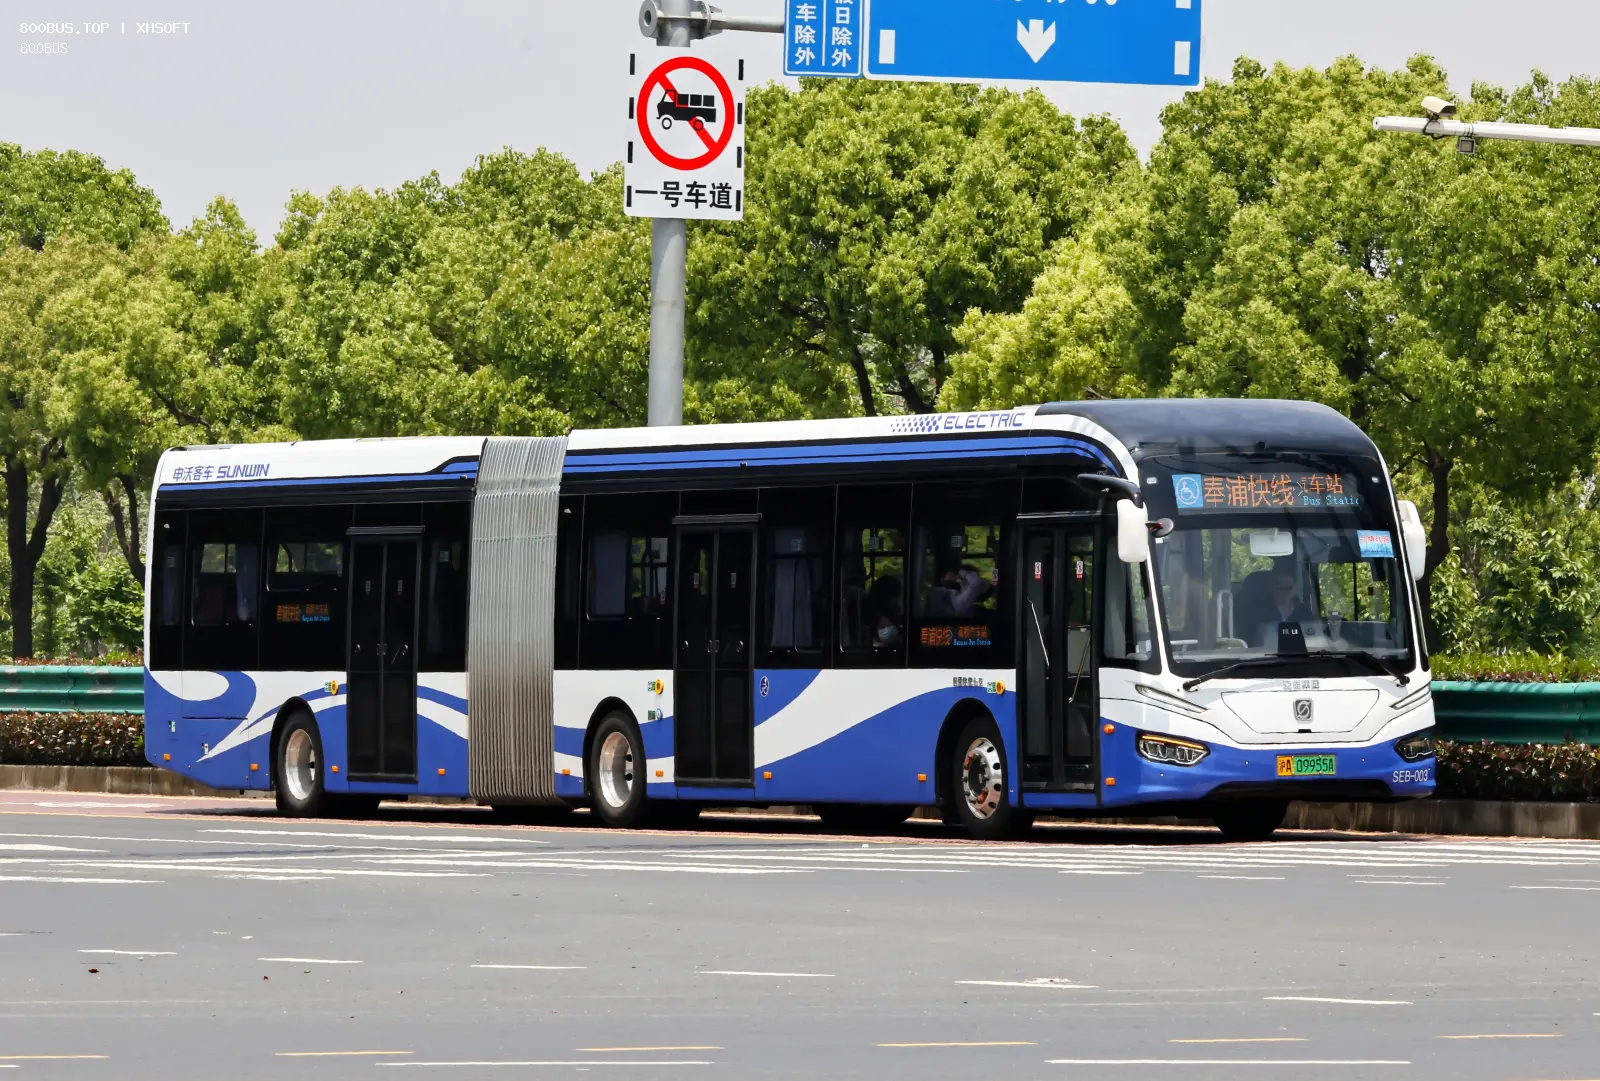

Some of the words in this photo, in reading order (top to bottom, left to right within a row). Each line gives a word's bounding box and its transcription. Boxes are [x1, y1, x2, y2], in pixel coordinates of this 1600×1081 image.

[831, 0, 854, 67] 日除外
[634, 180, 733, 209] 一号车道
[943, 412, 1026, 430] ELECTRIC
[172, 465, 215, 482] 申沃客车
[216, 463, 270, 479] SUNWIN
[1203, 474, 1295, 508] 奉浦快线
[1303, 495, 1321, 506] Bus
[1392, 770, 1429, 783] SEB-003
